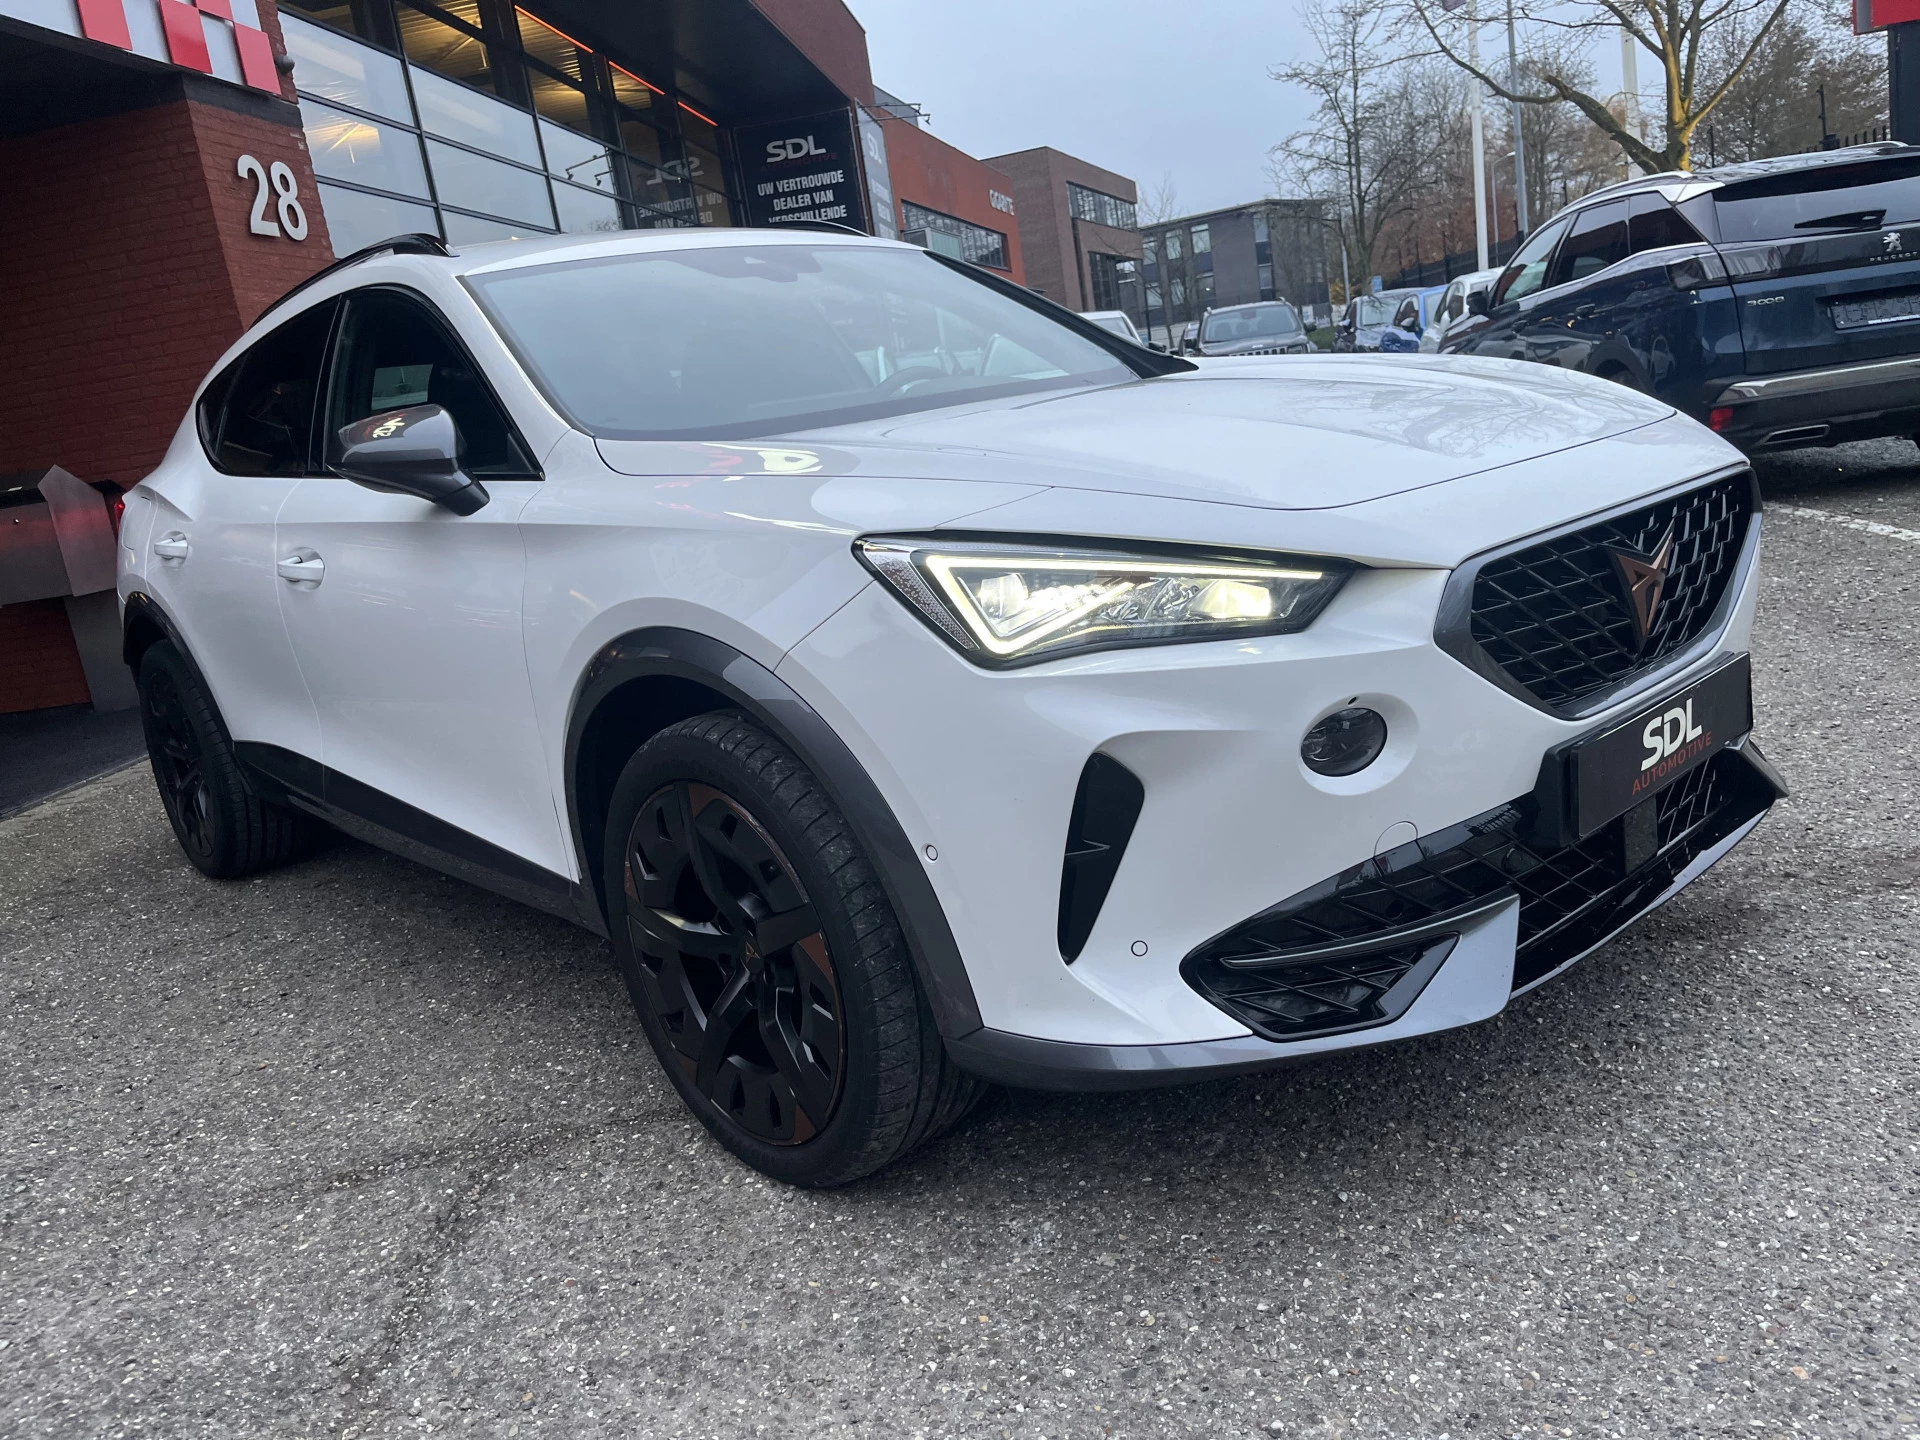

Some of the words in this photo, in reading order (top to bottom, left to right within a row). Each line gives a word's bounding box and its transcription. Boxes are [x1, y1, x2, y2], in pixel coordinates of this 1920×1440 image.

[766, 135, 827, 163] SDL
[757, 182, 774, 196] UW
[776, 169, 845, 193] VERTROUWDE
[237, 154, 308, 241] 28
[773, 193, 812, 211] DEALER
[812, 189, 834, 204] VAN
[1747, 296, 1785, 306] 3008
[1641, 698, 1703, 771] SDL
[1632, 731, 1712, 795] AUTOMOTIVE
